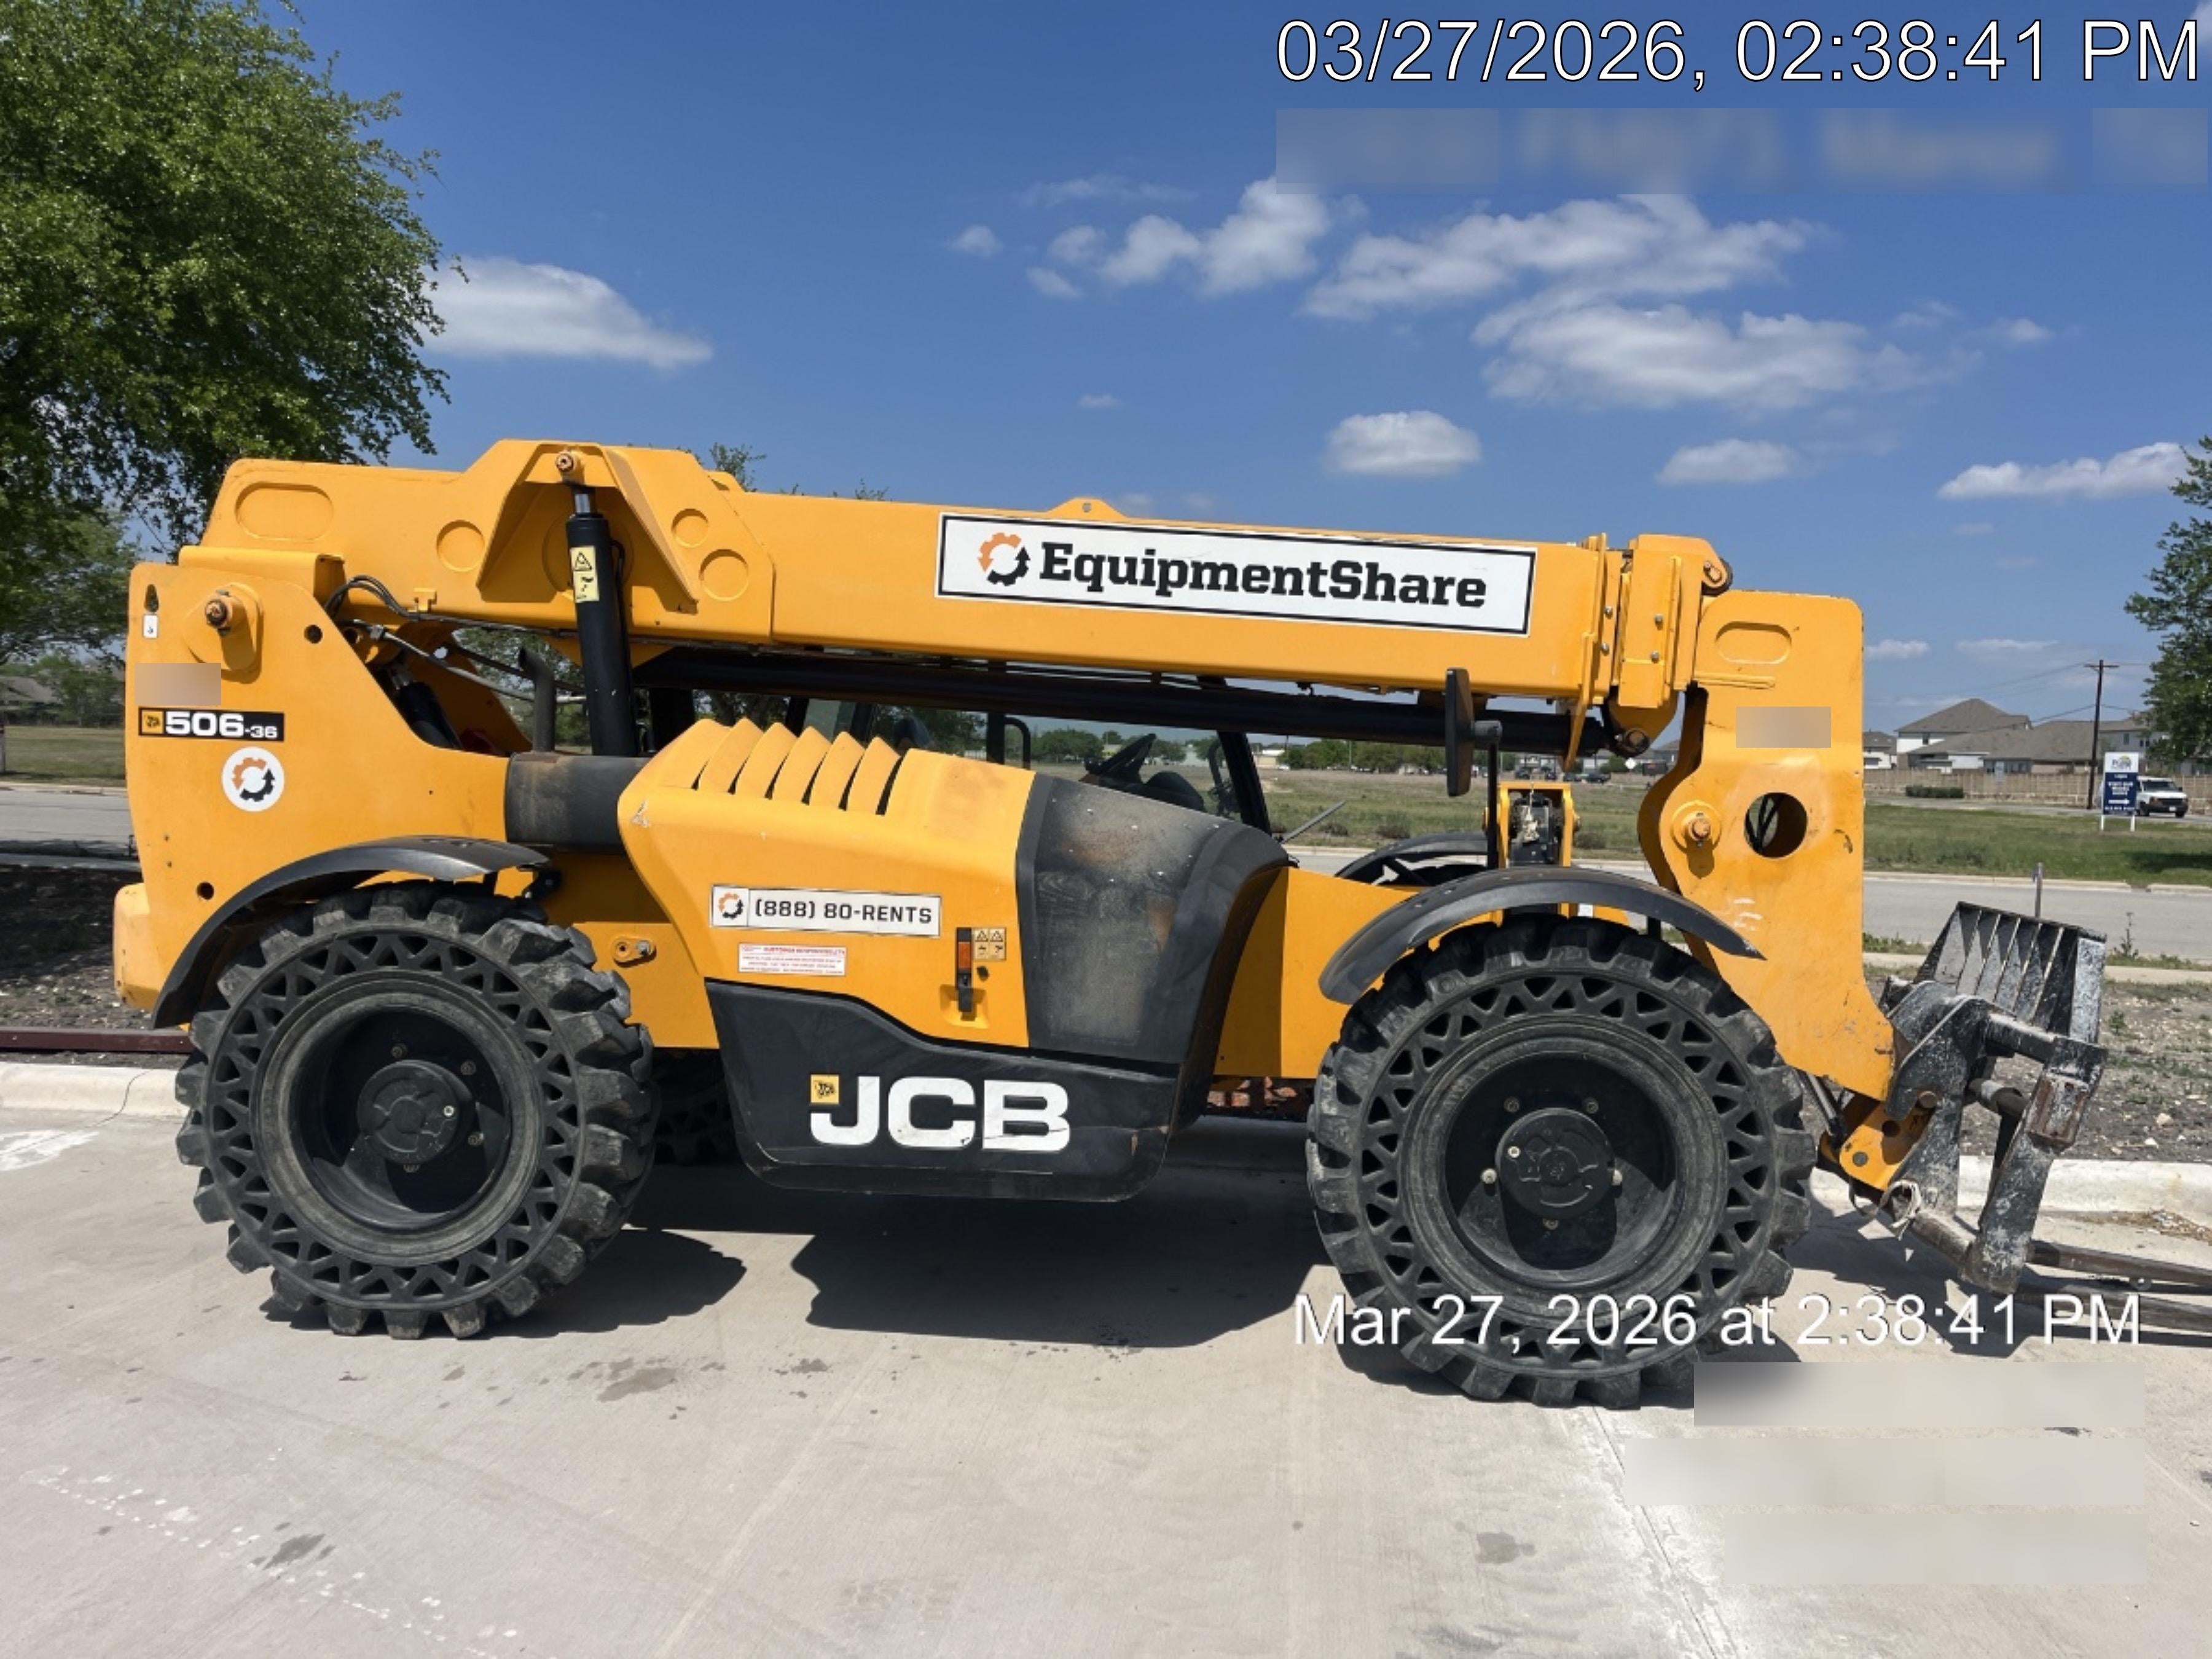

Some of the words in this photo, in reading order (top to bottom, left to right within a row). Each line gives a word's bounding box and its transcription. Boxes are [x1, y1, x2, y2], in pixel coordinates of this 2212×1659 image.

[1040, 542, 1487, 608] EquipmentShare
[755, 899, 816, 919] (888)
[824, 903, 931, 924] 80-RENTS
[810, 1075, 1070, 1152] JCB
